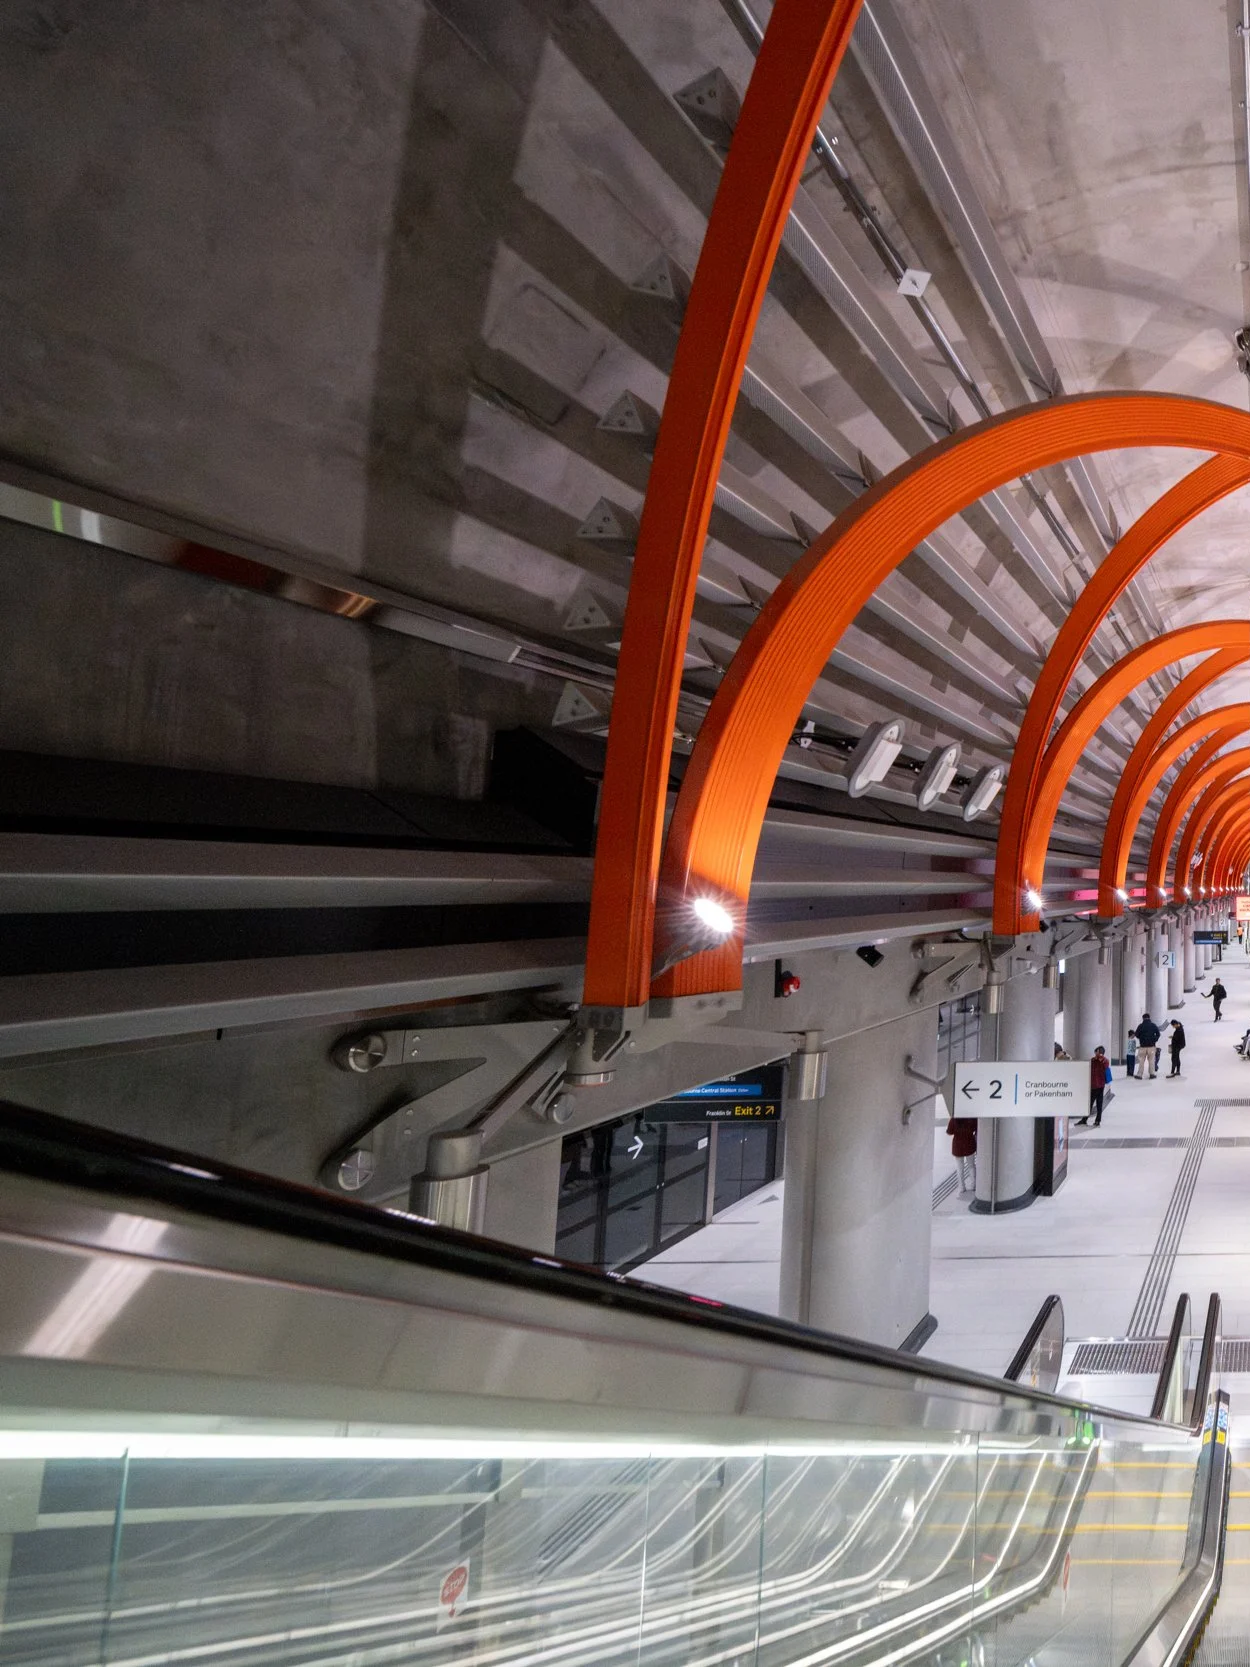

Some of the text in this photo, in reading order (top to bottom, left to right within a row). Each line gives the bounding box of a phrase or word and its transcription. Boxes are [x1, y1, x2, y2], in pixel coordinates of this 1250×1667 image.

[1162, 955, 1169, 965] 2
[989, 1080, 1003, 1099] 2
[1025, 1080, 1069, 1089] Cranbourne
[1034, 1090, 1073, 1098] Pakenham
[735, 1105, 761, 1116] Exit 2
